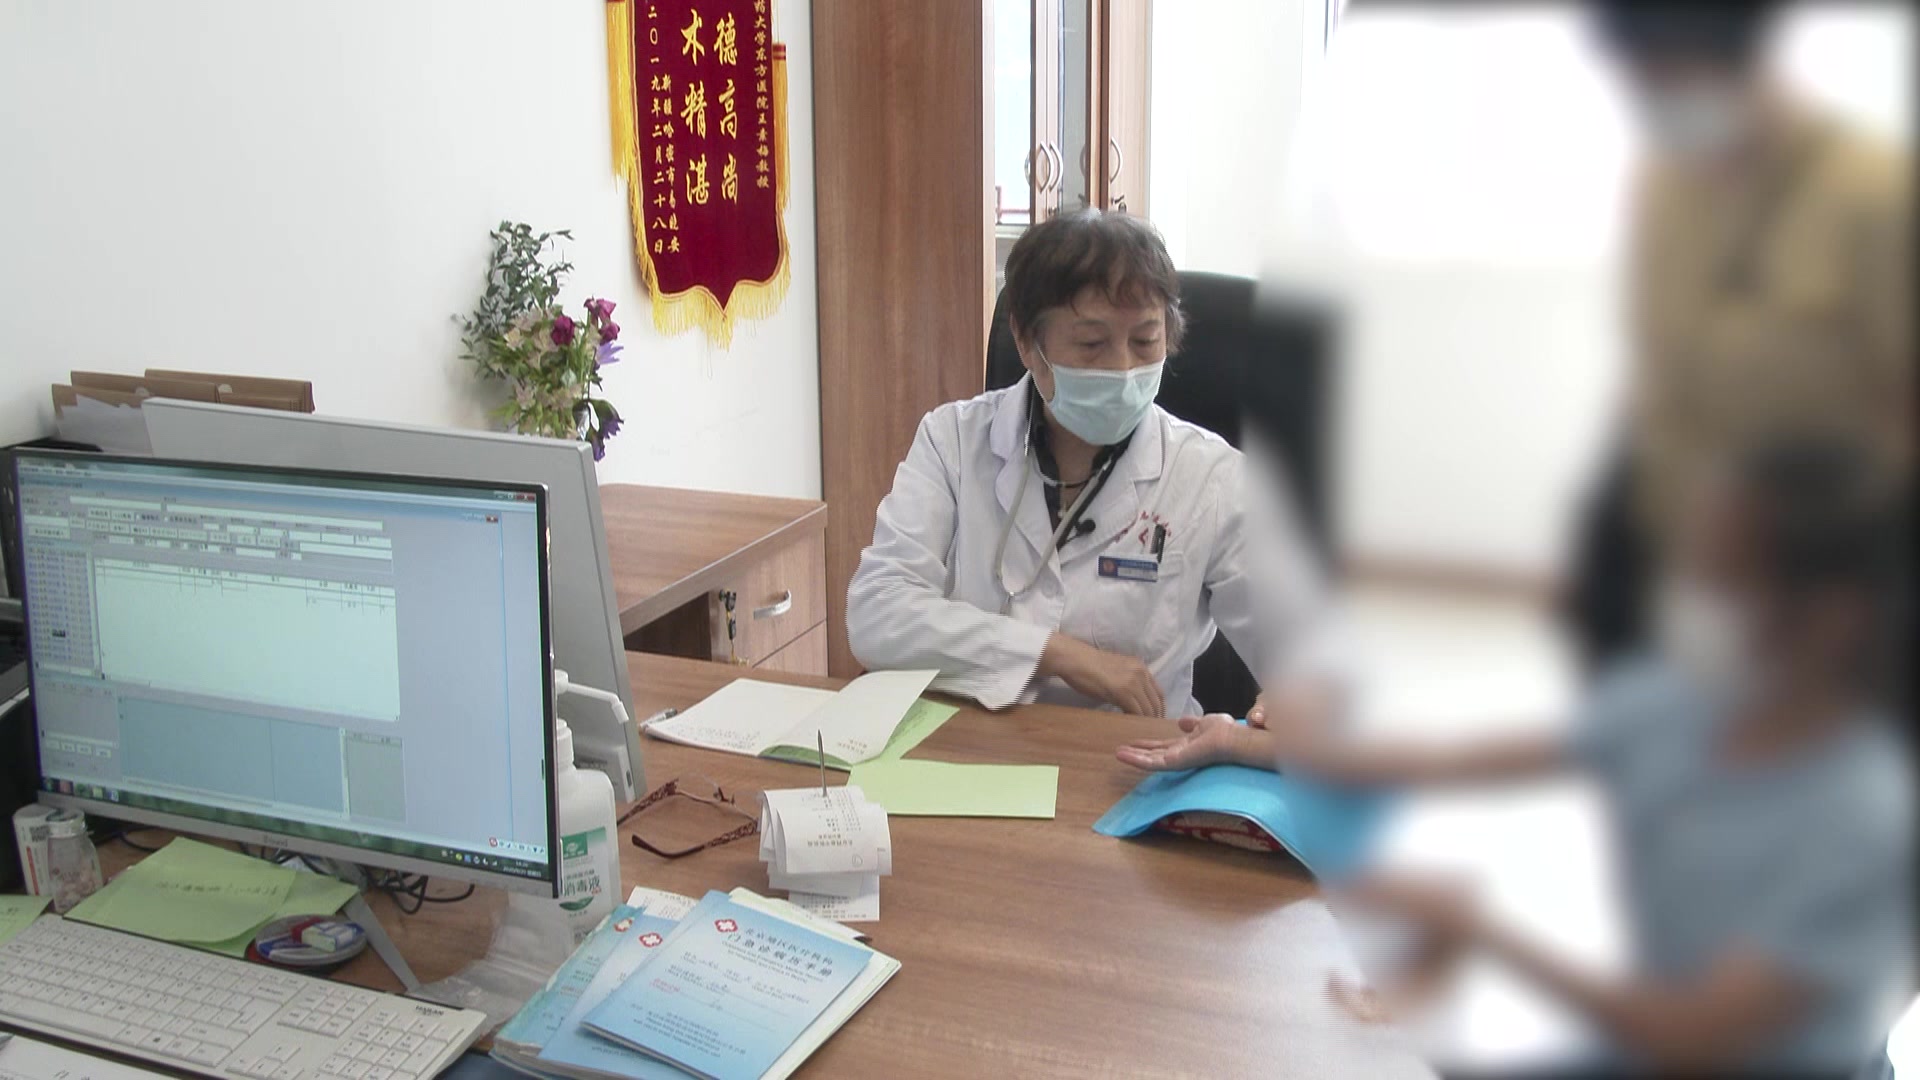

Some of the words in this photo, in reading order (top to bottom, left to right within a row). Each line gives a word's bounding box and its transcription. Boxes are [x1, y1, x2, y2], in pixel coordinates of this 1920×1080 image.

[681, 9, 710, 205] 术精湛
[713, 13, 739, 205] 德高尚
[728, 933, 832, 977] 门急诊病历手册
